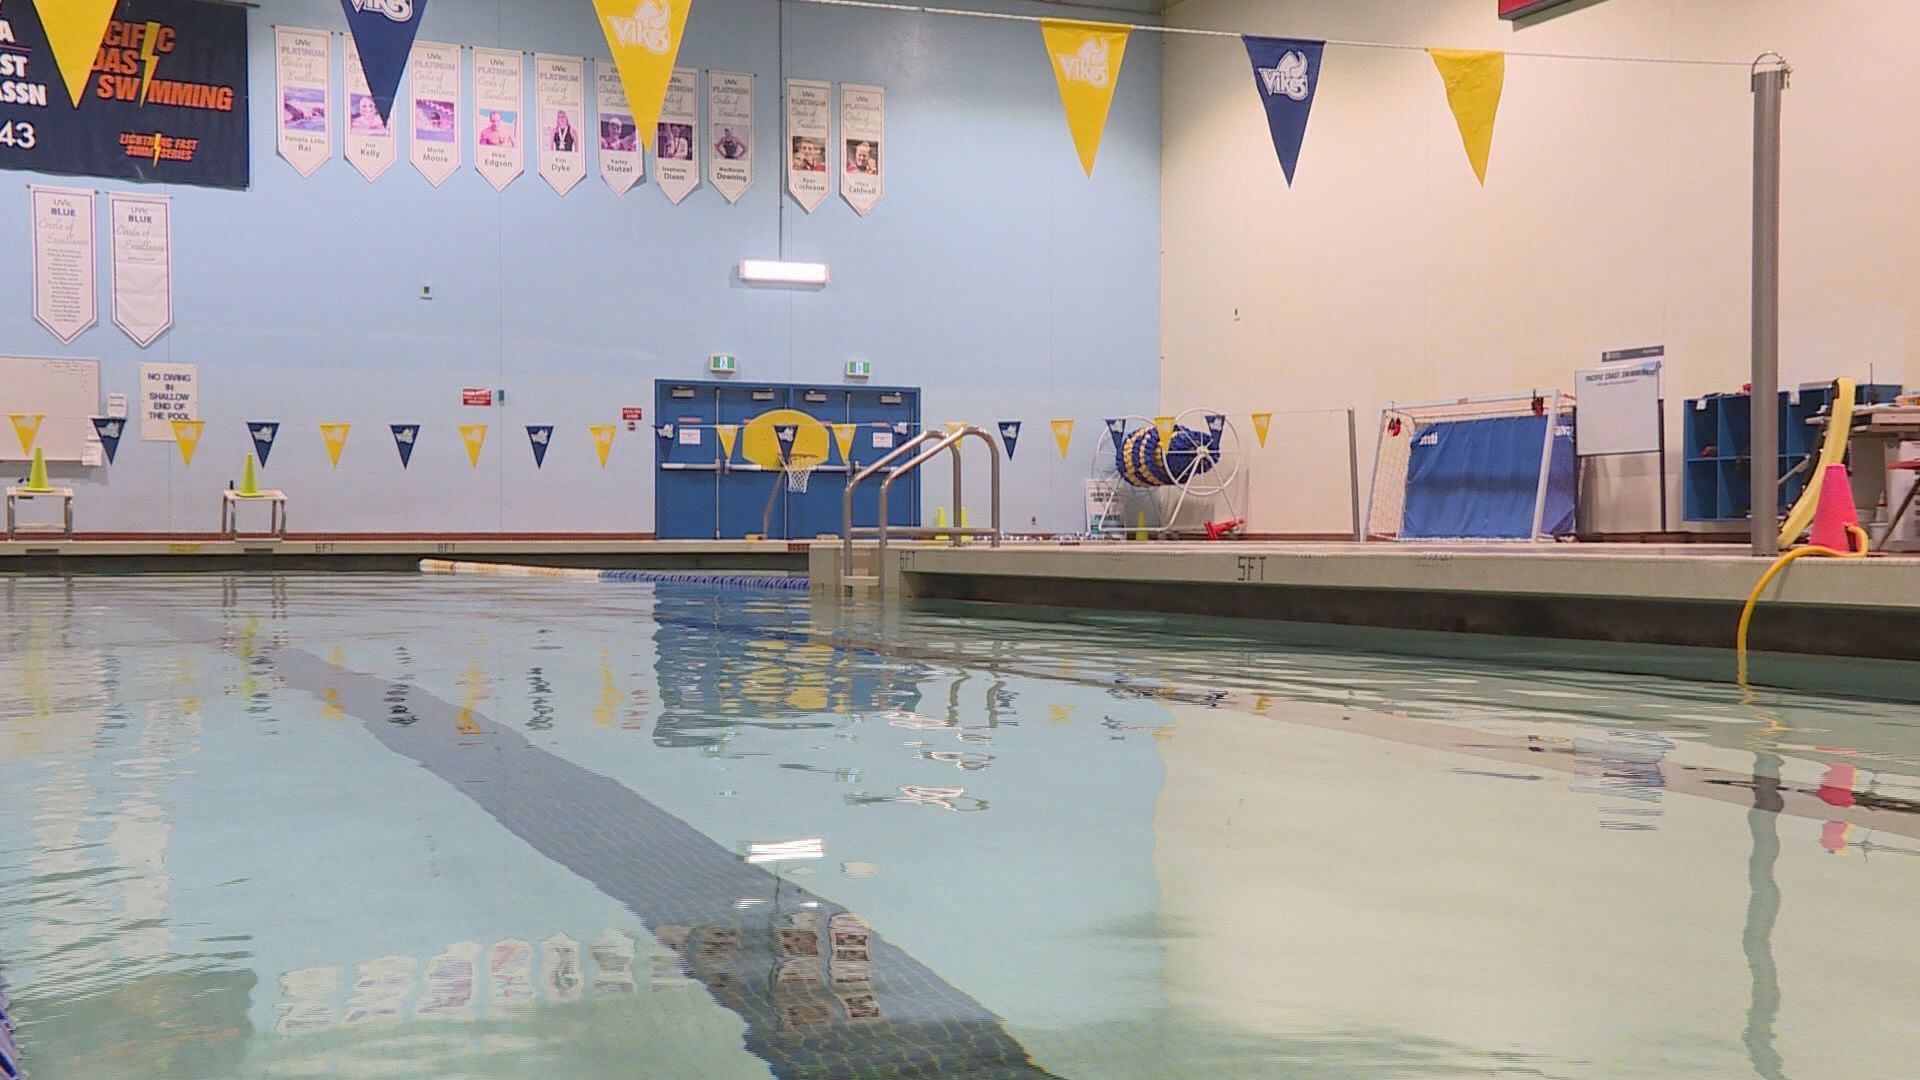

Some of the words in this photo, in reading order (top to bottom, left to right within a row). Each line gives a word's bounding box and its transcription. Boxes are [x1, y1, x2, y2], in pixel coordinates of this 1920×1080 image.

[281, 46, 325, 57] PLATINUM
[414, 62, 456, 71] PLATINUM
[477, 66, 518, 76] PLATINUM
[539, 73, 579, 82] PLATINUM
[1258, 68, 1308, 100] Viks
[0, 80, 47, 106] SSN
[712, 86, 749, 95] PLATINUM
[791, 98, 826, 107] PLATINUM
[175, 138, 199, 150] FAST
[360, 149, 380, 159] Kelly
[423, 154, 449, 163] Moore
[485, 158, 513, 168] Edgson
[551, 163, 571, 173] Dyke
[663, 172, 685, 181] Dixon
[716, 172, 747, 183] Downing
[794, 182, 826, 193] Cochrane
[848, 185, 877, 195] Caldwell
[50, 207, 77, 217] BLUE
[128, 215, 153, 224] BLUE
[147, 372, 161, 381] NO
[163, 373, 191, 382] DIVING
[165, 383, 174, 391] IN
[148, 392, 190, 401] SHALLOW
[153, 401, 171, 410] END
[173, 402, 185, 410] OF
[148, 411, 164, 420] THE
[167, 412, 191, 421] POOL
[1237, 555, 1266, 581] 5FT
